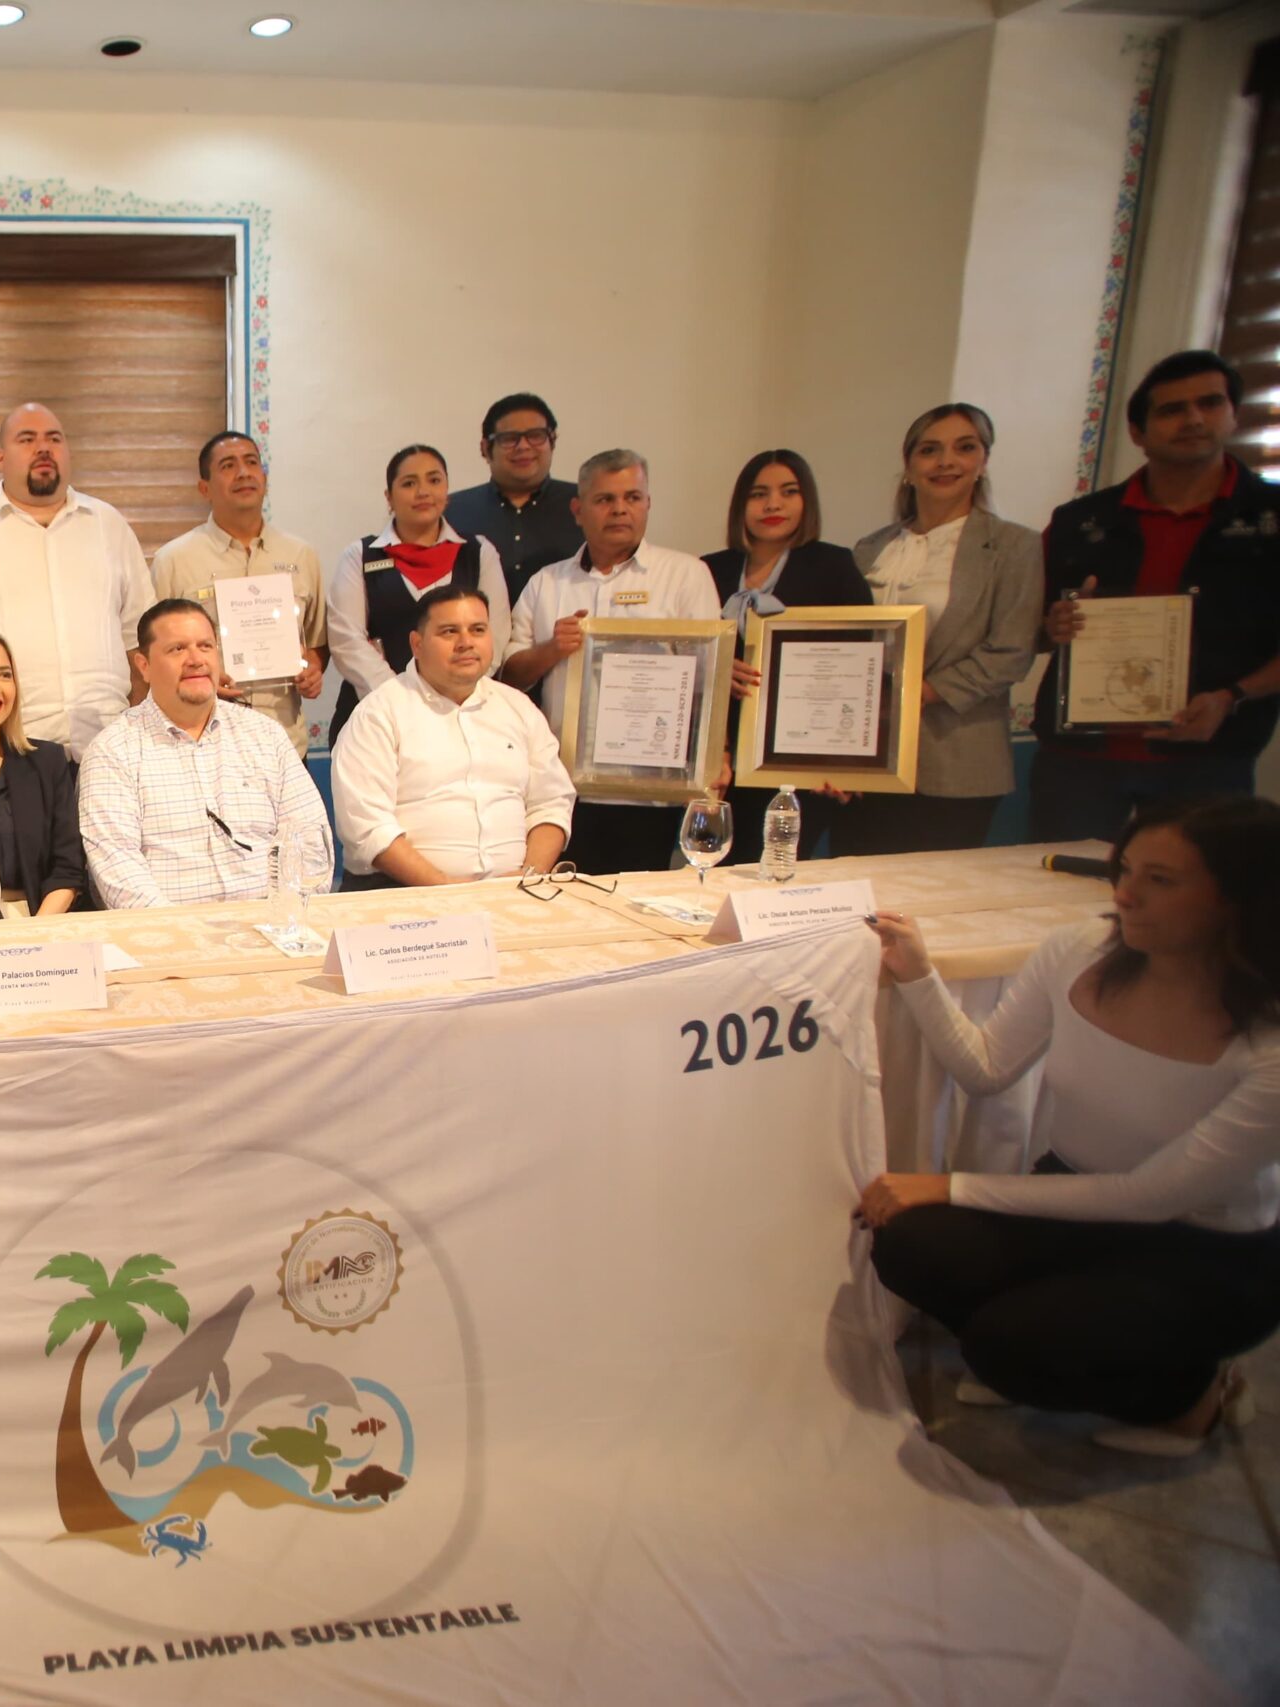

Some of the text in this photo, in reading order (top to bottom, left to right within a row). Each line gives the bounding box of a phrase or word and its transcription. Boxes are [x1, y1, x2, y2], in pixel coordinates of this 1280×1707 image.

[365, 949, 377, 958] Lic.
[379, 946, 401, 956] Carlos
[435, 938, 468, 949] Sacristán
[2, 970, 34, 980] Palacios
[680, 999, 819, 1073] 2026
[43, 1602, 520, 1675] PLAYA LIMPIA SUSTENTABLE
